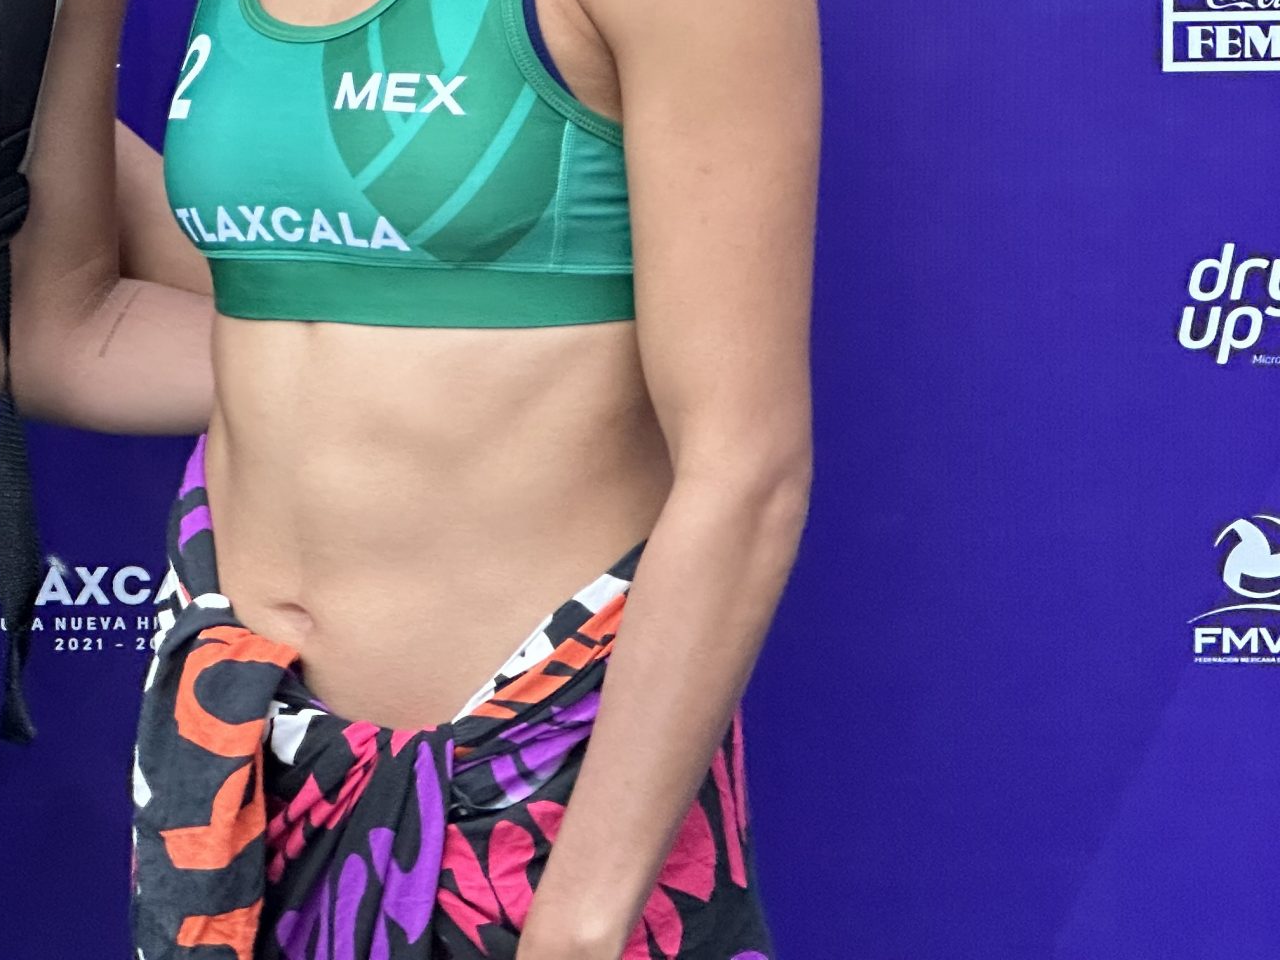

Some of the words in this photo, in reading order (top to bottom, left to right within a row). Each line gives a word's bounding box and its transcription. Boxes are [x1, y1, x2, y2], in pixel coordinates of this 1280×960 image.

[334, 71, 467, 116] MEX
[176, 205, 411, 251] TLAXCALA
[1178, 306, 1263, 365] up
[55, 616, 126, 631] NUEVA
[55, 637, 104, 651] 2021
